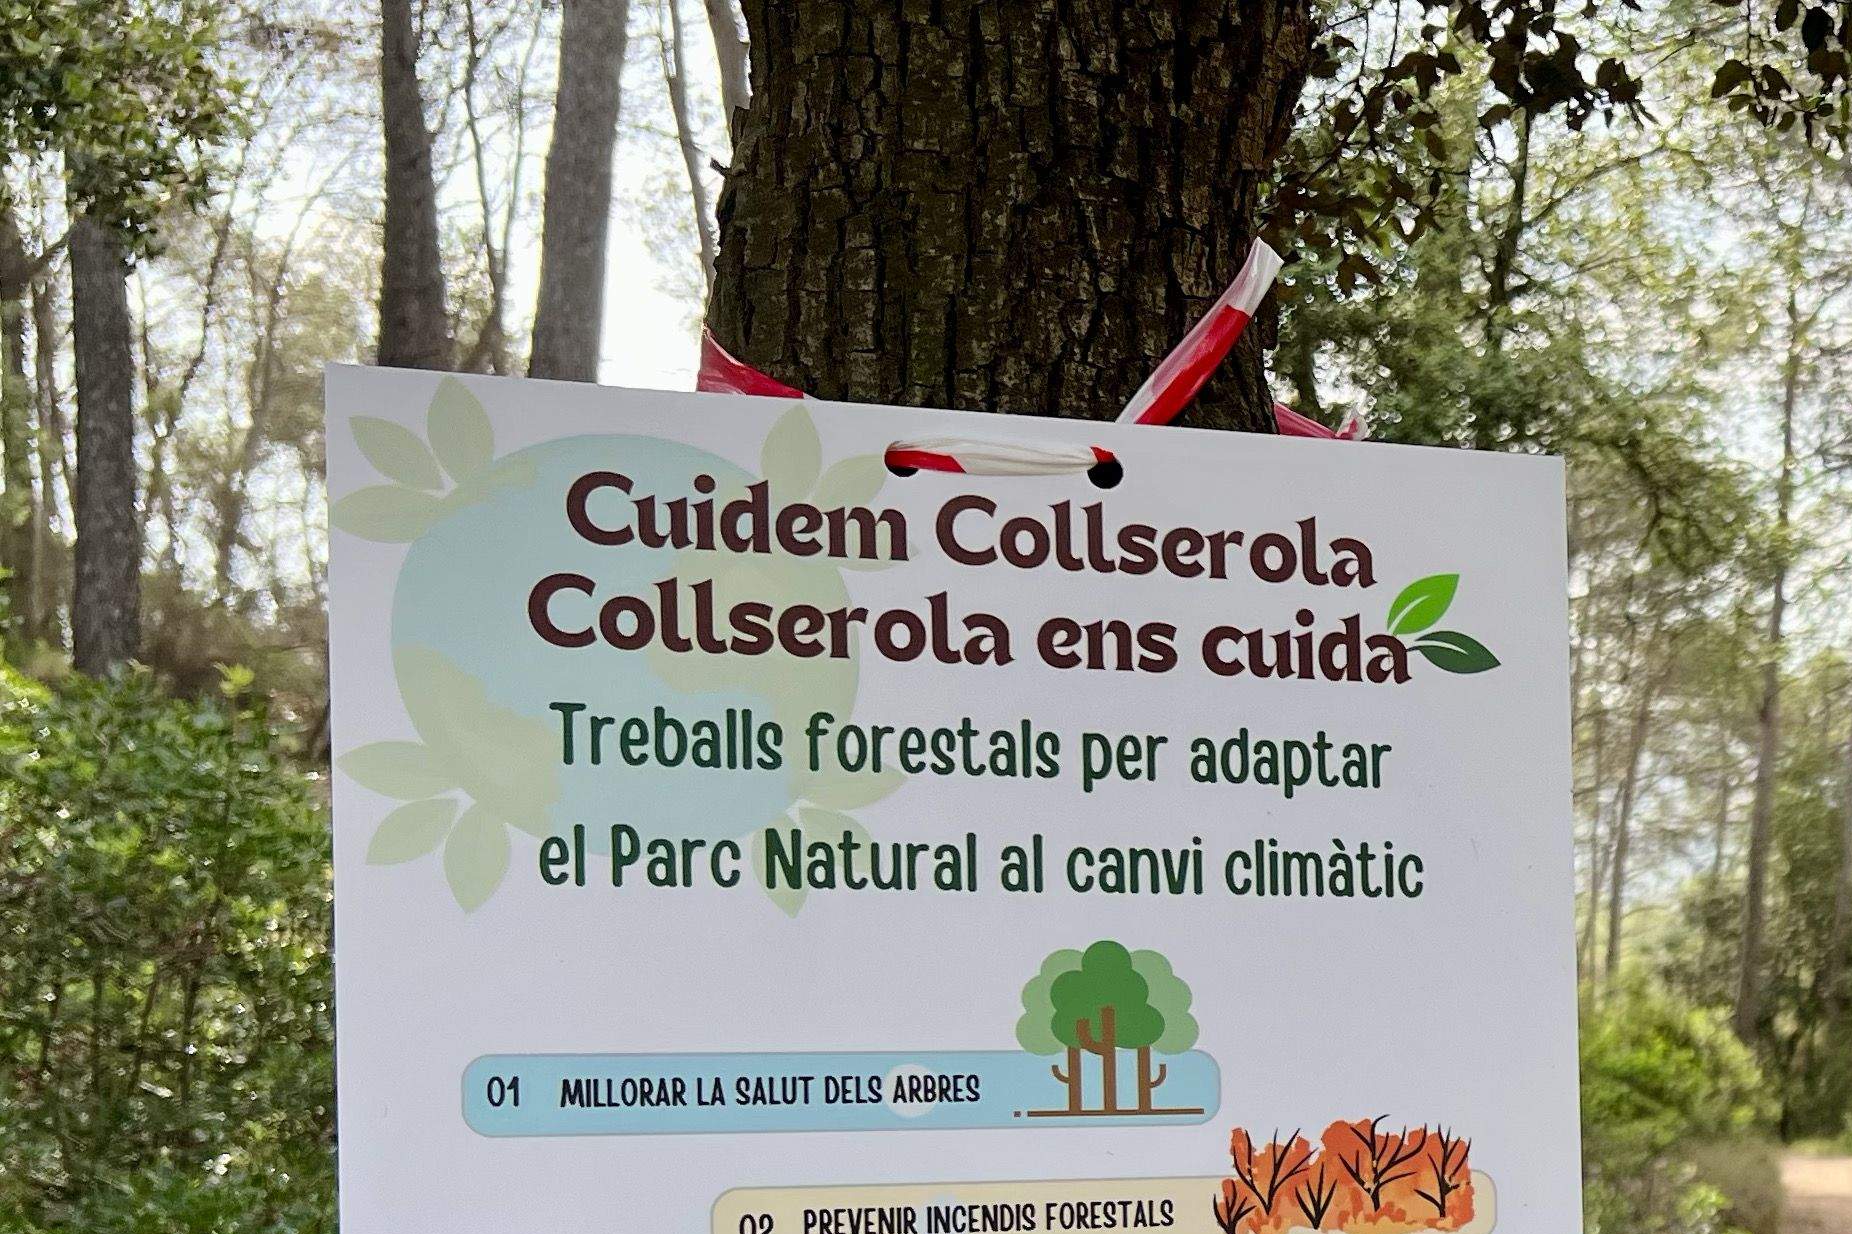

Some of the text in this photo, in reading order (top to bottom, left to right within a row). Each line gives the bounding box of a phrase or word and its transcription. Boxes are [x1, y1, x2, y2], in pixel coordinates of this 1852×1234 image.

[564, 470, 1375, 590] Cuidem Collserola
[526, 571, 1414, 686] Collserola ens cuida
[549, 701, 1392, 799] Treballs forestals per adaptar
[539, 823, 1423, 900] el Parc Natural al canvi climàtic
[487, 1074, 982, 1109] 01 MILLORAR LA SALUT DELS ARBRES
[1045, 1199, 1175, 1232] FORESTALS
